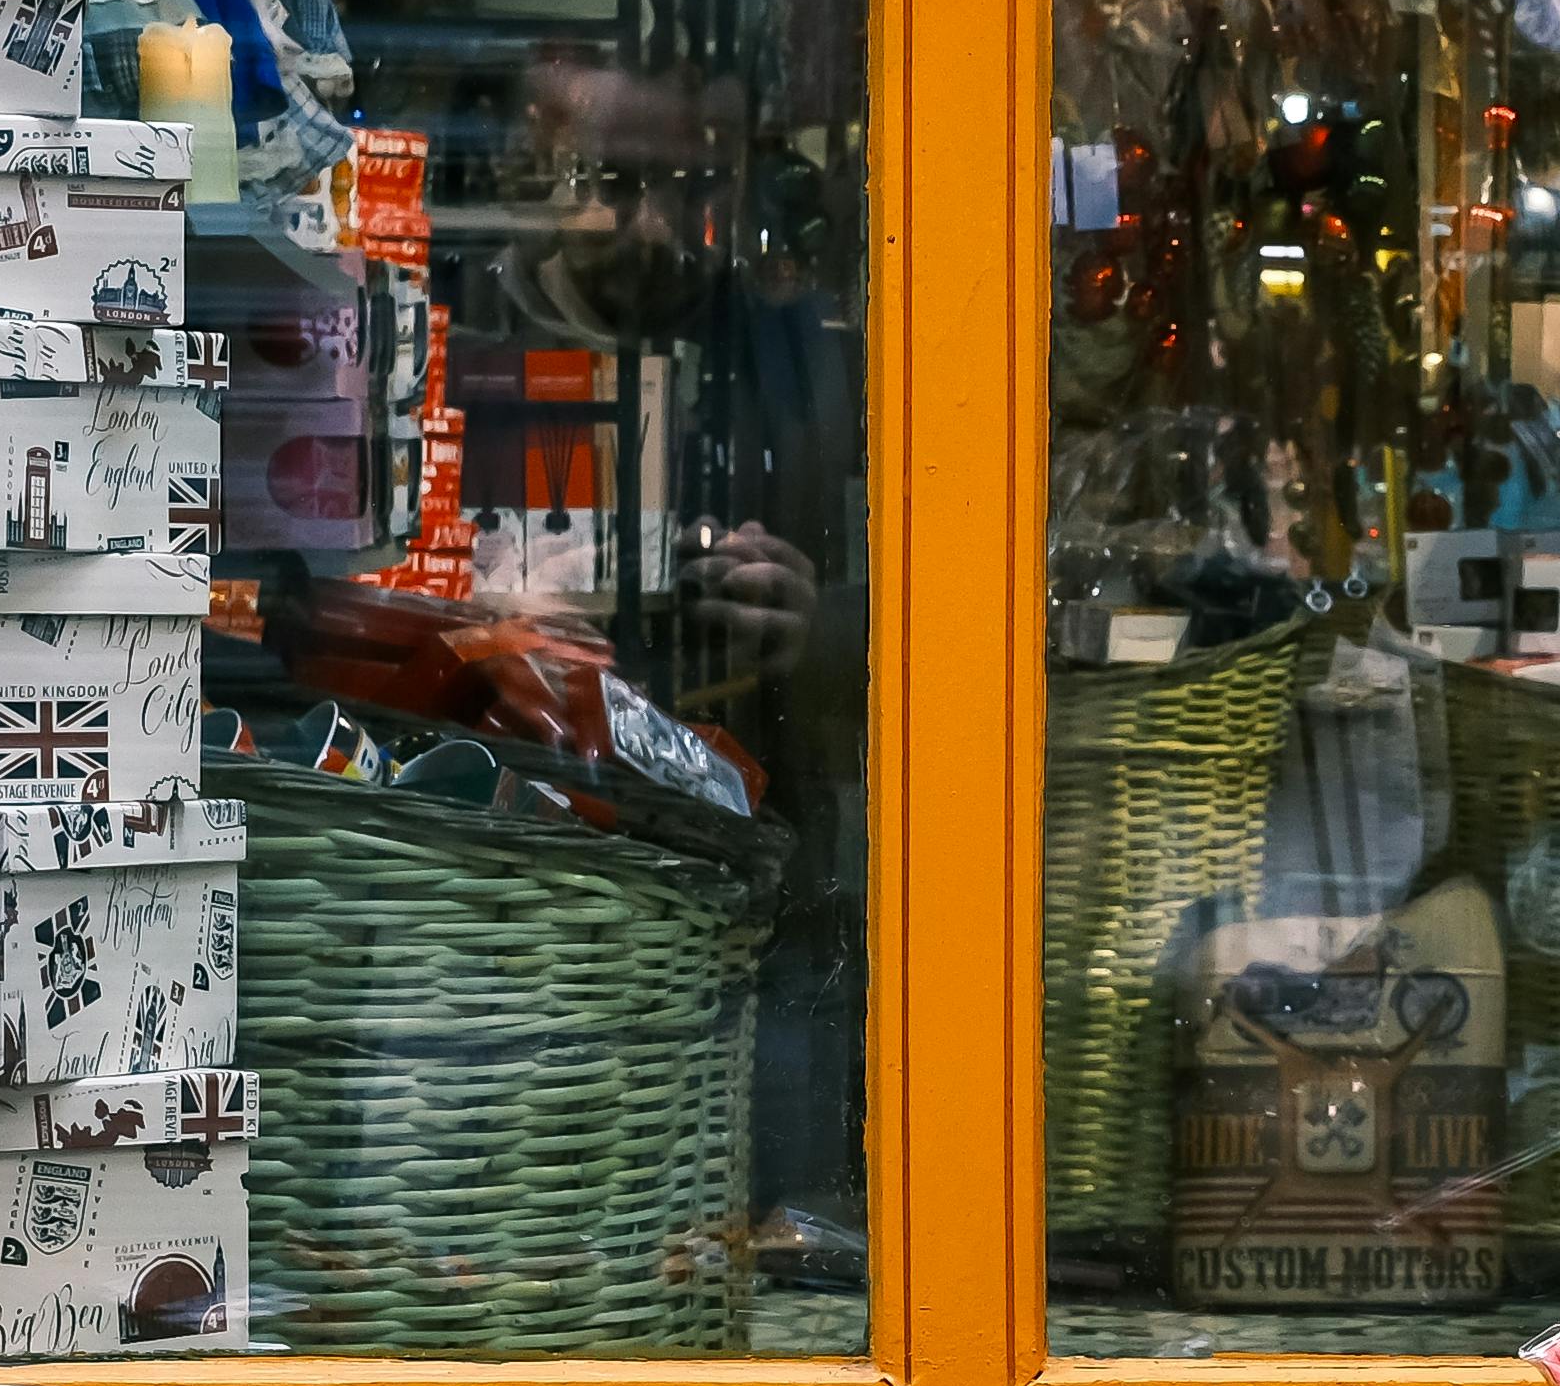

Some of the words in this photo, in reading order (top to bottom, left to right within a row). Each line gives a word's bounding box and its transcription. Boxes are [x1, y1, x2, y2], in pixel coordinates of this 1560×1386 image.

[106, 310, 151, 321] LONDON
[169, 462, 207, 474] UNITED
[113, 629, 201, 694] Lond
[42, 685, 110, 698] KINGDOM
[31, 782, 77, 798] REVENUE
[1403, 1114, 1489, 1168] LIVE
[36, 1164, 89, 1180] ENGLAND
[114, 1242, 163, 1254] POSTAGE
[167, 1235, 216, 1248] REVENUE
[1177, 1246, 1329, 1291] CUSTOM
[1341, 1245, 1496, 1291] MOTORS
